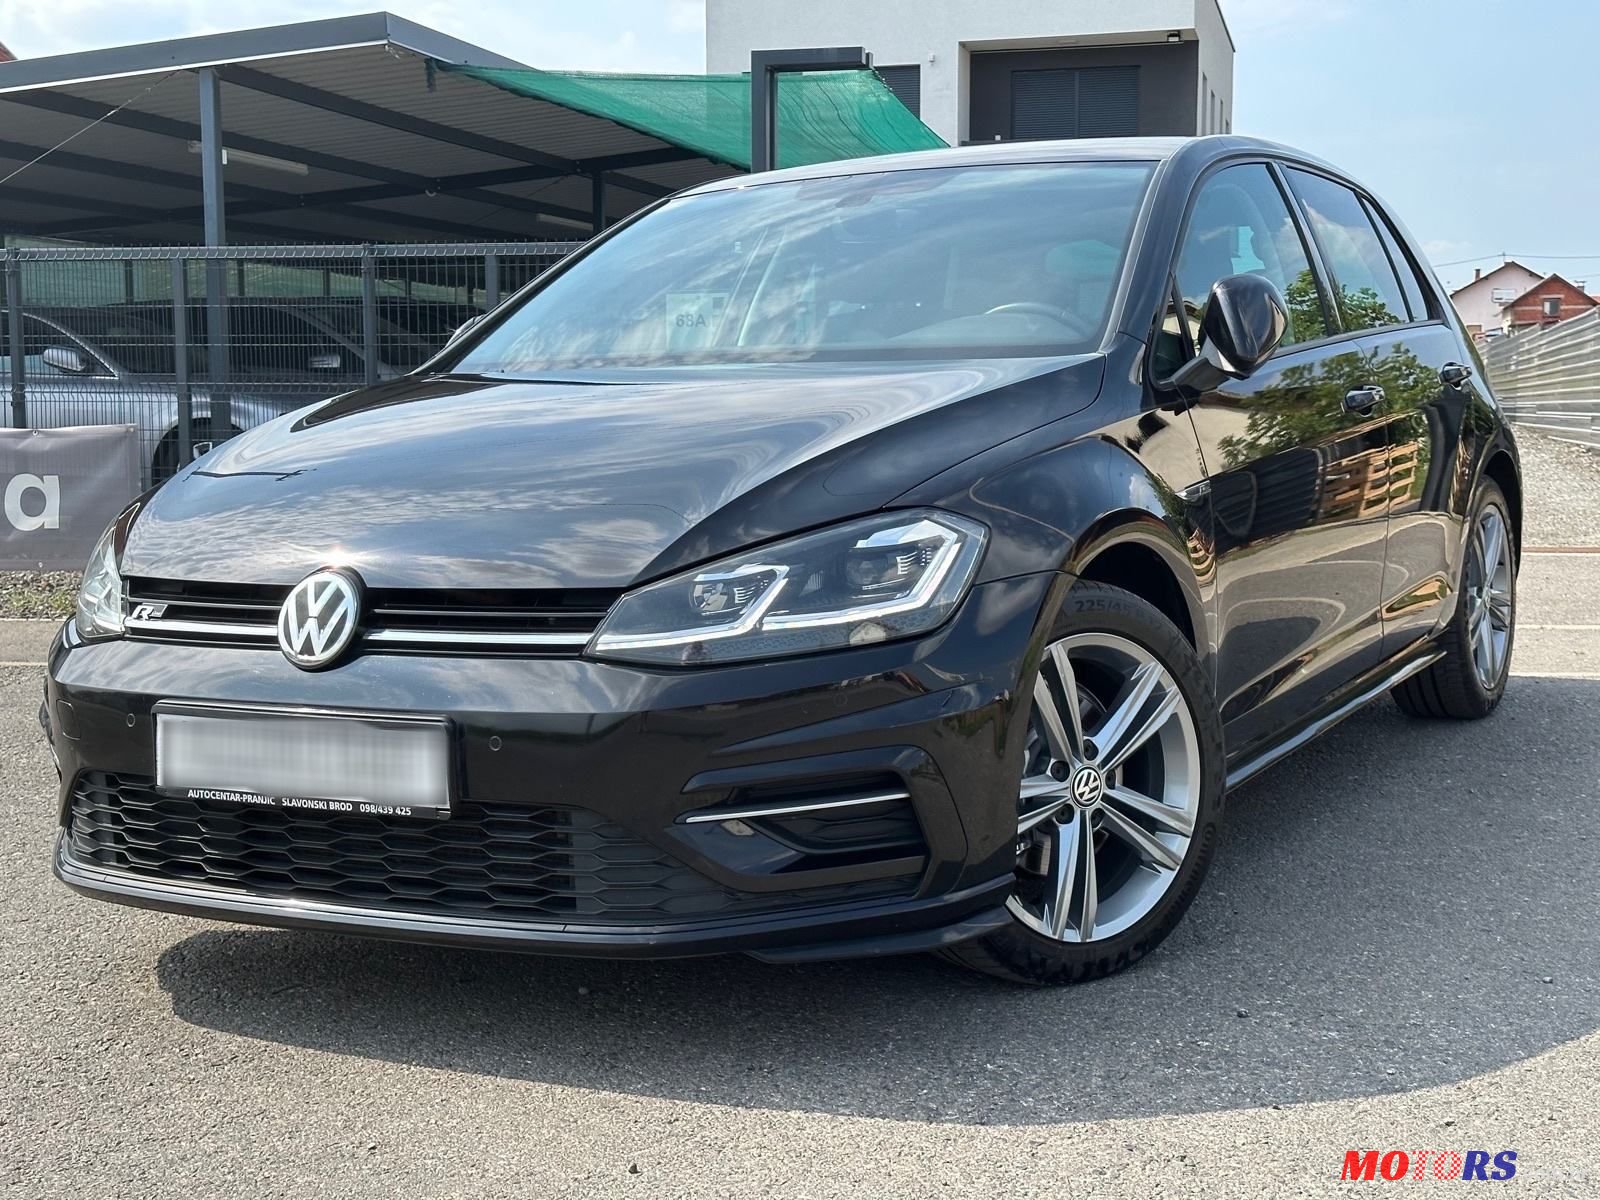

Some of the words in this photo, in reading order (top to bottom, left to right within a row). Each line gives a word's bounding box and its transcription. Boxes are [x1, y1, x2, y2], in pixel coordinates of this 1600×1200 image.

[676, 313, 706, 328] 68A
[281, 797, 328, 811] SLAVONSKI
[329, 801, 353, 812] BROD
[359, 803, 393, 815] 098/439
[395, 806, 412, 816] 425
